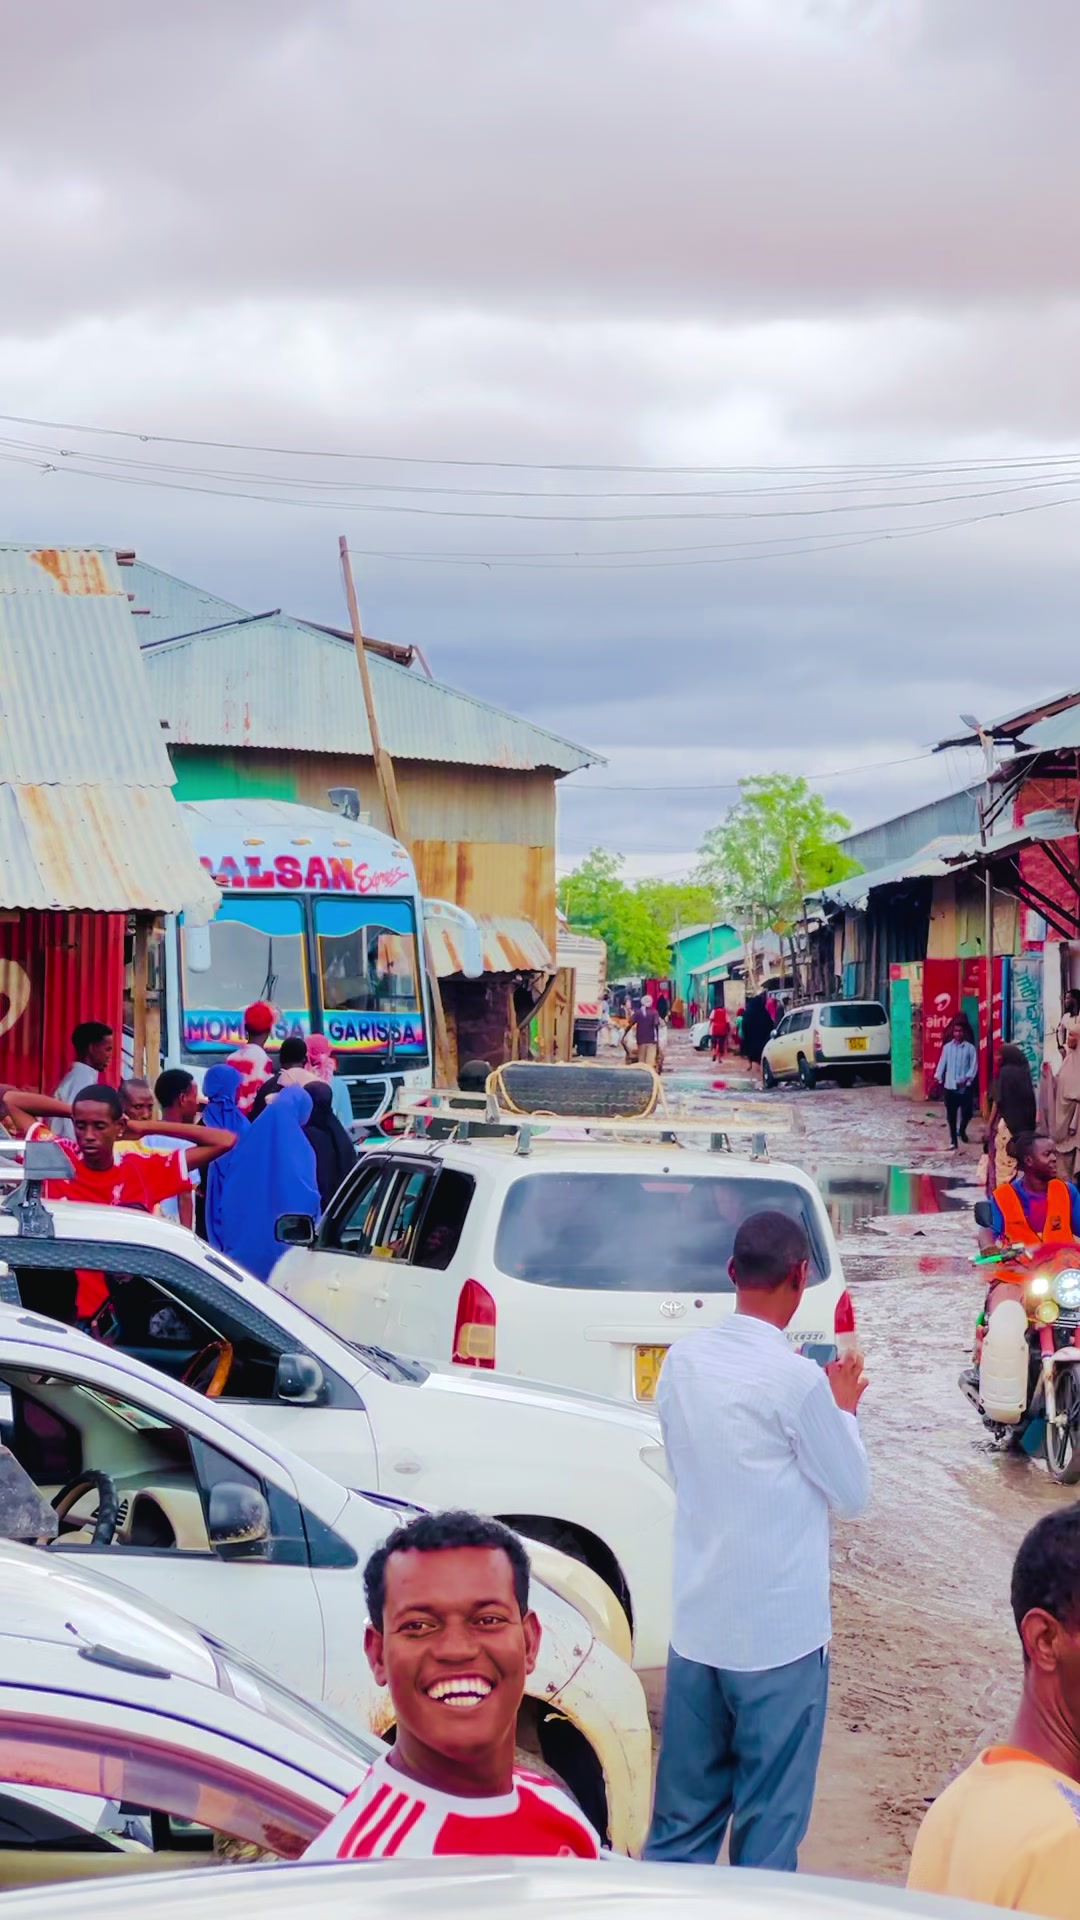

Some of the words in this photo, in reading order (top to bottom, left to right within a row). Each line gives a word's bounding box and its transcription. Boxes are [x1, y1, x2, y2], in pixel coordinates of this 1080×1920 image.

[187, 1015, 304, 1041] MOMSA
[329, 1018, 416, 1042] GARISSA
[926, 1014, 953, 1029] airt
